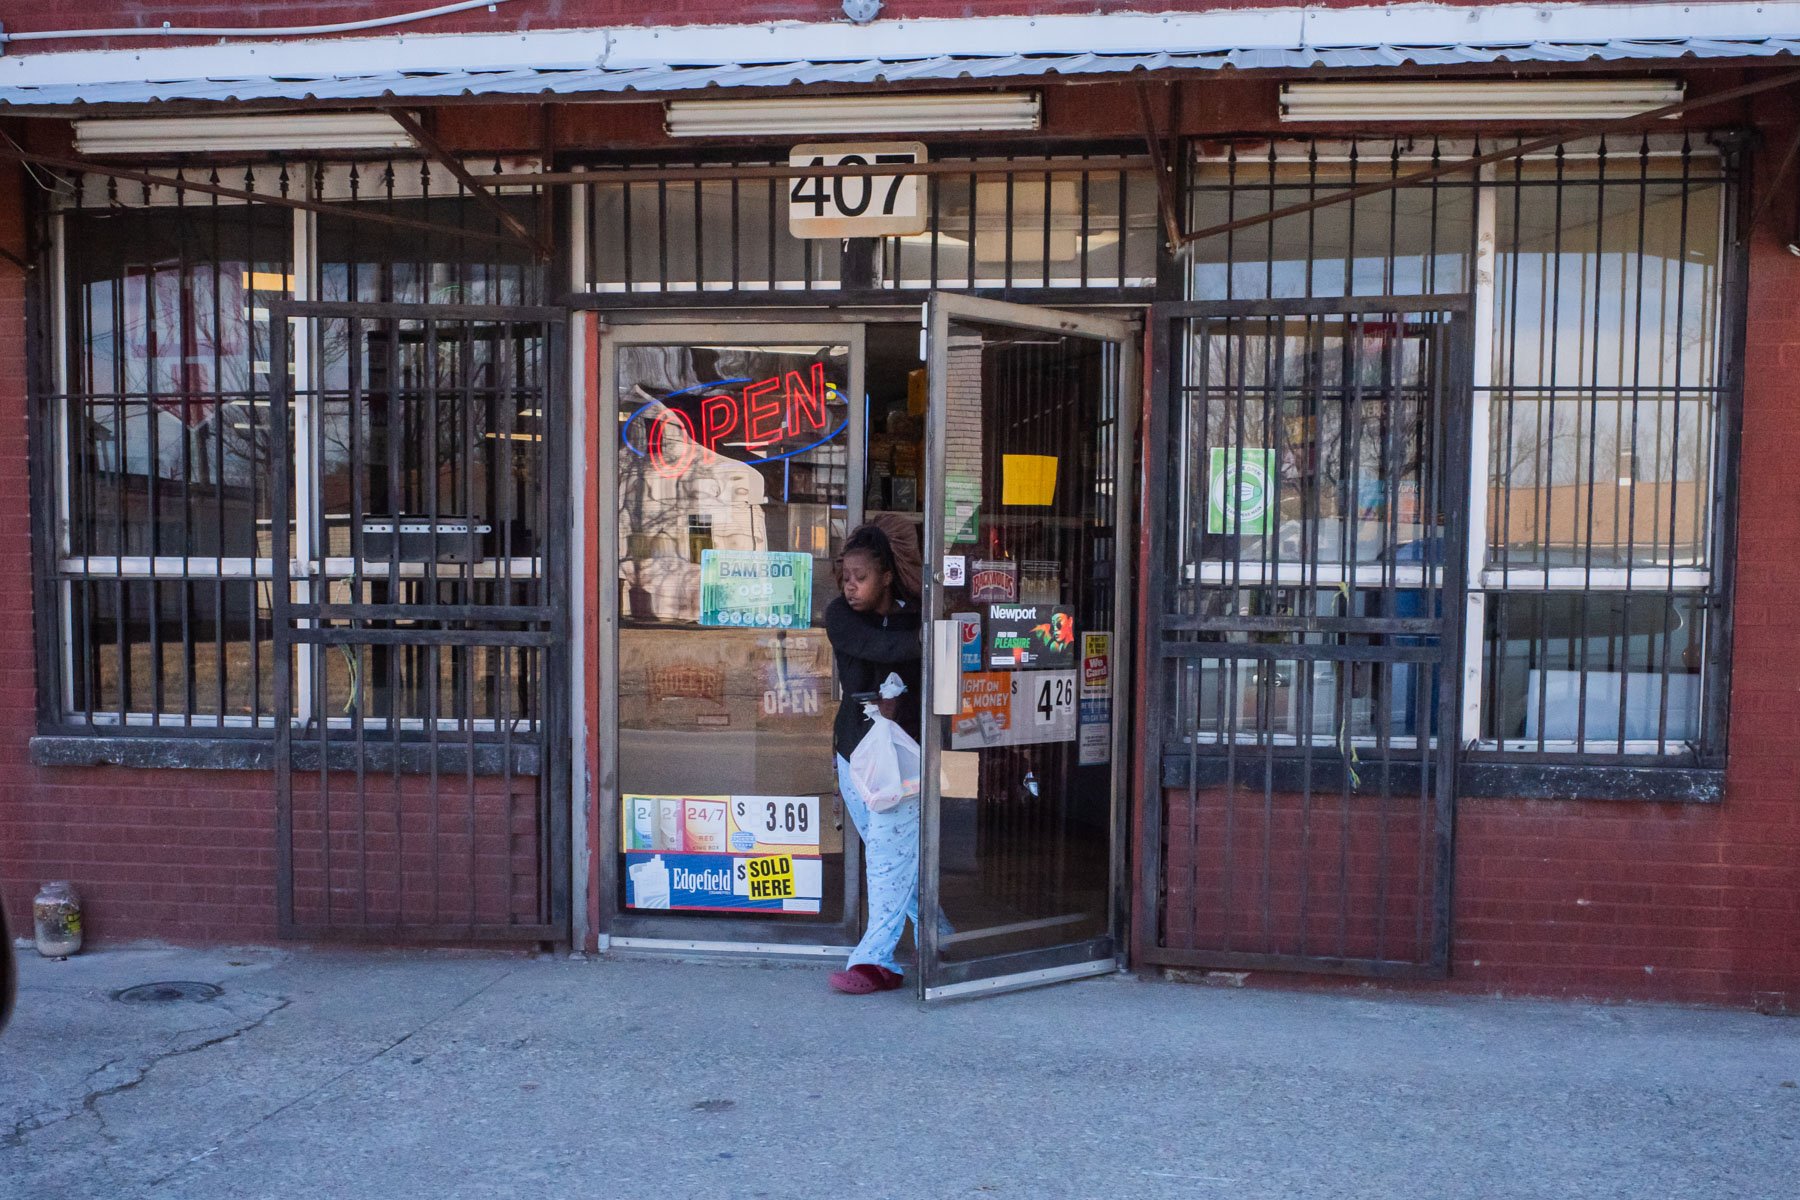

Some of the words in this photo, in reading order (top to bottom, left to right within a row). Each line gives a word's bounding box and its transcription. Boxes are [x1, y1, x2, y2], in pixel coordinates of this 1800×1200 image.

[791, 154, 915, 217] 407
[649, 362, 827, 479] OPEN
[719, 561, 793, 578] BAMBOO
[990, 605, 1037, 622] Newport
[994, 637, 1031, 649] PLEASURE
[987, 681, 999, 691] ON
[763, 689, 819, 715] OPEN
[973, 693, 1009, 707] MONEY
[688, 807, 724, 822] 24/7
[737, 802, 745, 817] $
[766, 802, 808, 832] 3.69
[750, 858, 790, 877] SOLD
[673, 868, 731, 893] Edgefield
[751, 879, 792, 897] HERE
